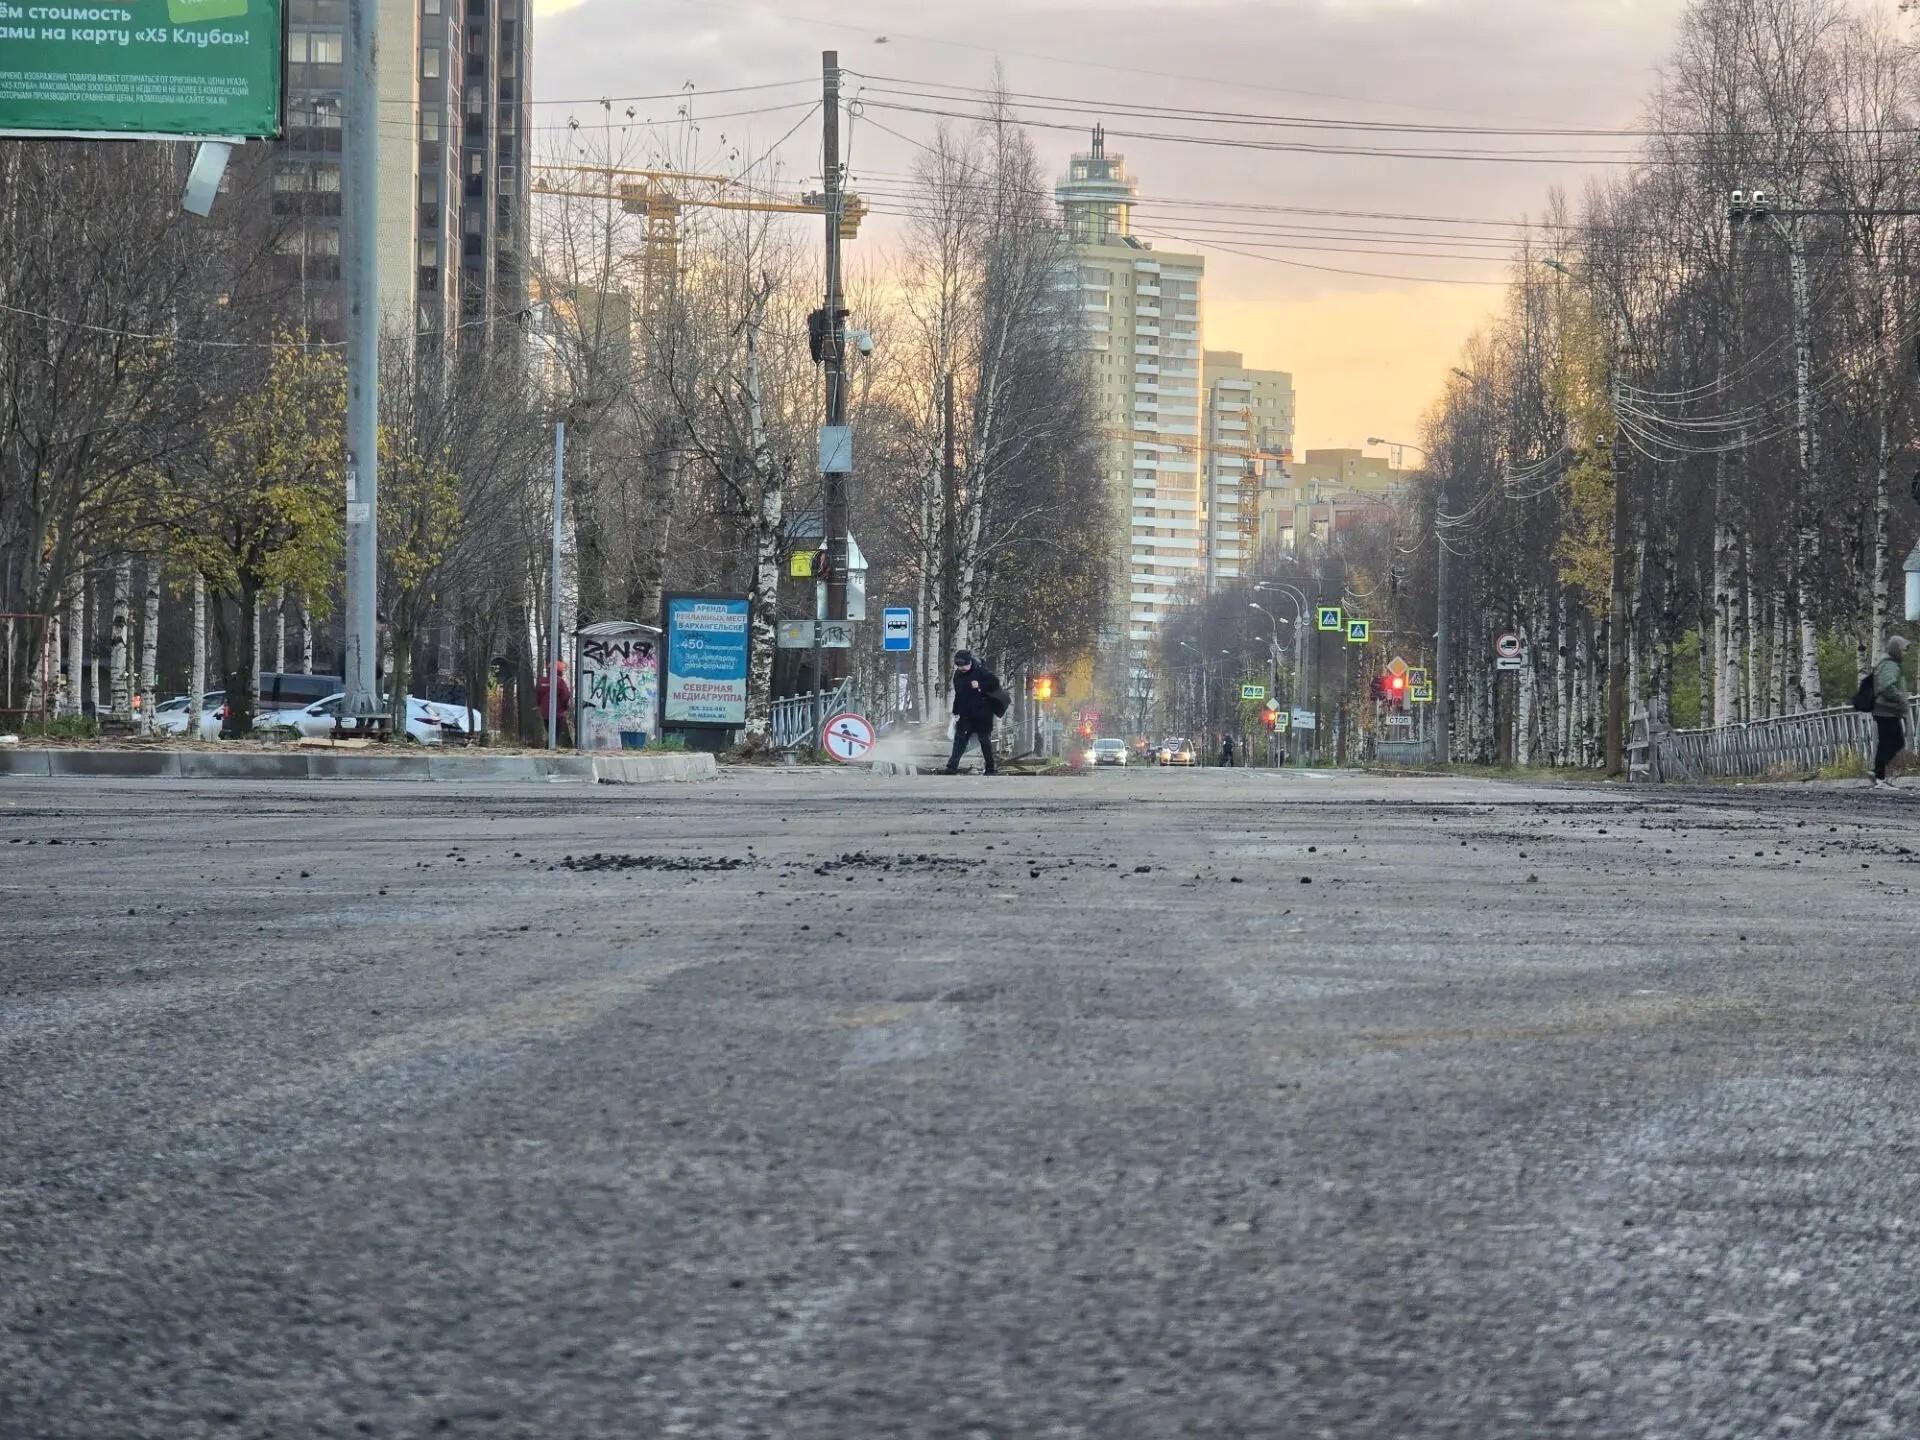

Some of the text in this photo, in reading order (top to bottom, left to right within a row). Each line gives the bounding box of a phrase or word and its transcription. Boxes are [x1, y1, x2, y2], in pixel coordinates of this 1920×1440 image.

[28, 7, 131, 21] стоимость
[41, 28, 66, 40] на
[71, 28, 129, 46] карту
[173, 28, 249, 48] Клуба»!
[696, 605, 727, 614] АРЕНДА
[726, 614, 747, 623] МЕСТ
[685, 623, 743, 632] АРХАНГЕЛЬСКЕ
[683, 683, 734, 693] СЕВЕРНАЯ
[672, 692, 743, 702] МЕДИАГРУППА
